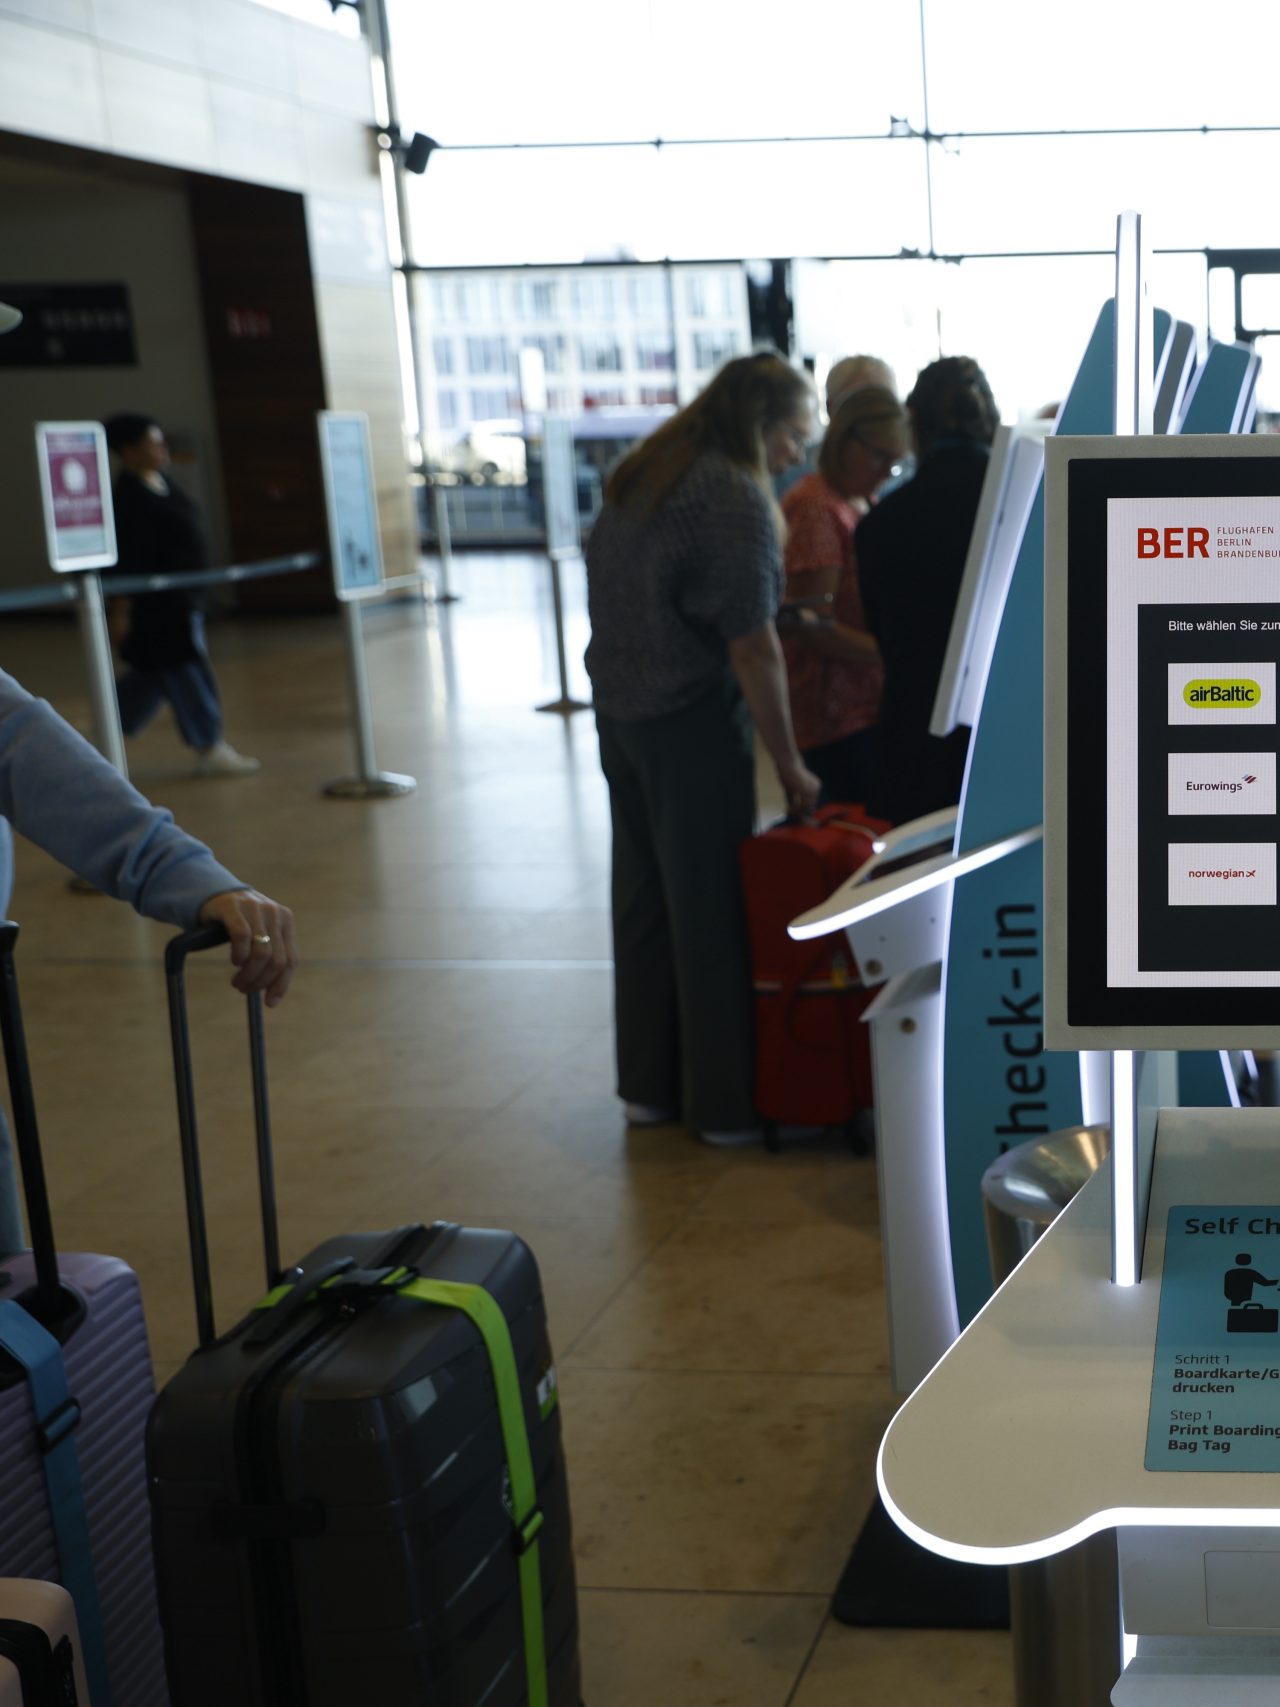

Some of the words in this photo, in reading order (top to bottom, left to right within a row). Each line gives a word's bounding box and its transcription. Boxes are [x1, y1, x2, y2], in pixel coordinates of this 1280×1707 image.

[1217, 526, 1274, 535] FLUGHAFEN
[1137, 527, 1210, 559] BER
[1217, 538, 1252, 547] BERLIN
[1169, 620, 1193, 632] Bitte
[1197, 620, 1236, 631] wählen
[1240, 619, 1257, 631] Sie
[1190, 686, 1255, 702] airBaltic
[1186, 780, 1243, 793] Eurowings
[1188, 868, 1246, 880] norwegian
[983, 904, 1048, 1155] heck-in
[1184, 1216, 1240, 1235] Self
[1175, 1354, 1220, 1365] Schritt
[1224, 1354, 1230, 1364] 1
[1172, 1382, 1235, 1393] drucken
[1170, 1409, 1202, 1422] Step
[1206, 1410, 1213, 1421] 1
[1169, 1424, 1209, 1436] Print
[1168, 1440, 1198, 1453] Bag
[1203, 1440, 1231, 1453] Tag
